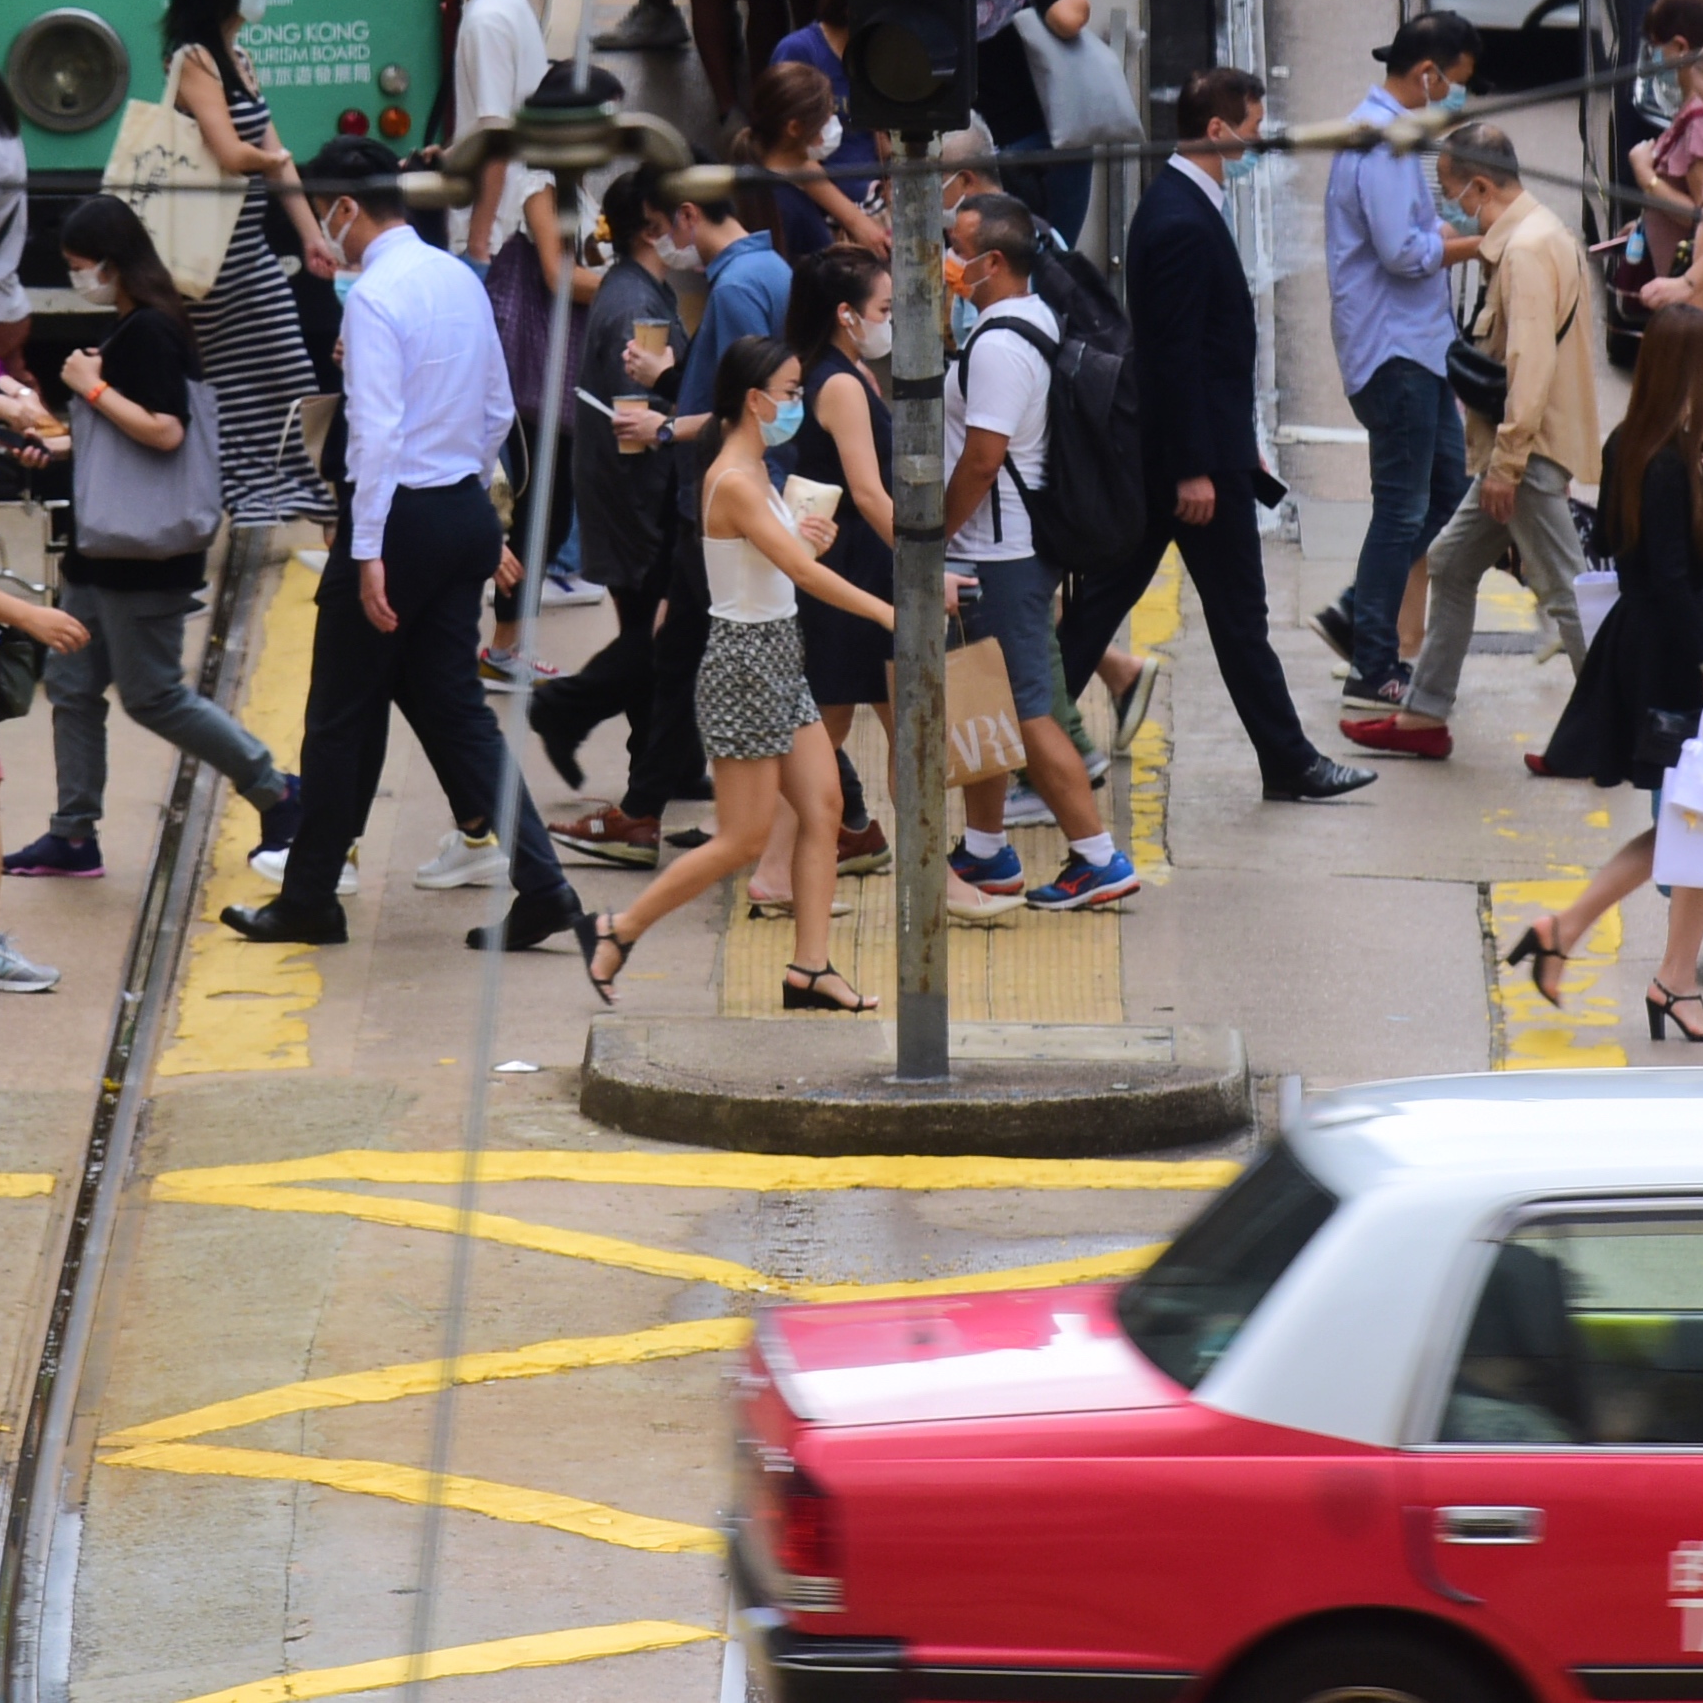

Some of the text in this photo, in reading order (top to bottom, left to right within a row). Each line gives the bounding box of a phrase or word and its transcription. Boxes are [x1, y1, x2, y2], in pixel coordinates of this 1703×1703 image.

[235, 20, 370, 46] HONG KONG
[250, 45, 370, 65] OURISM BOARD
[259, 63, 371, 87] 港旅遊發展局
[946, 709, 1026, 779] ARA
